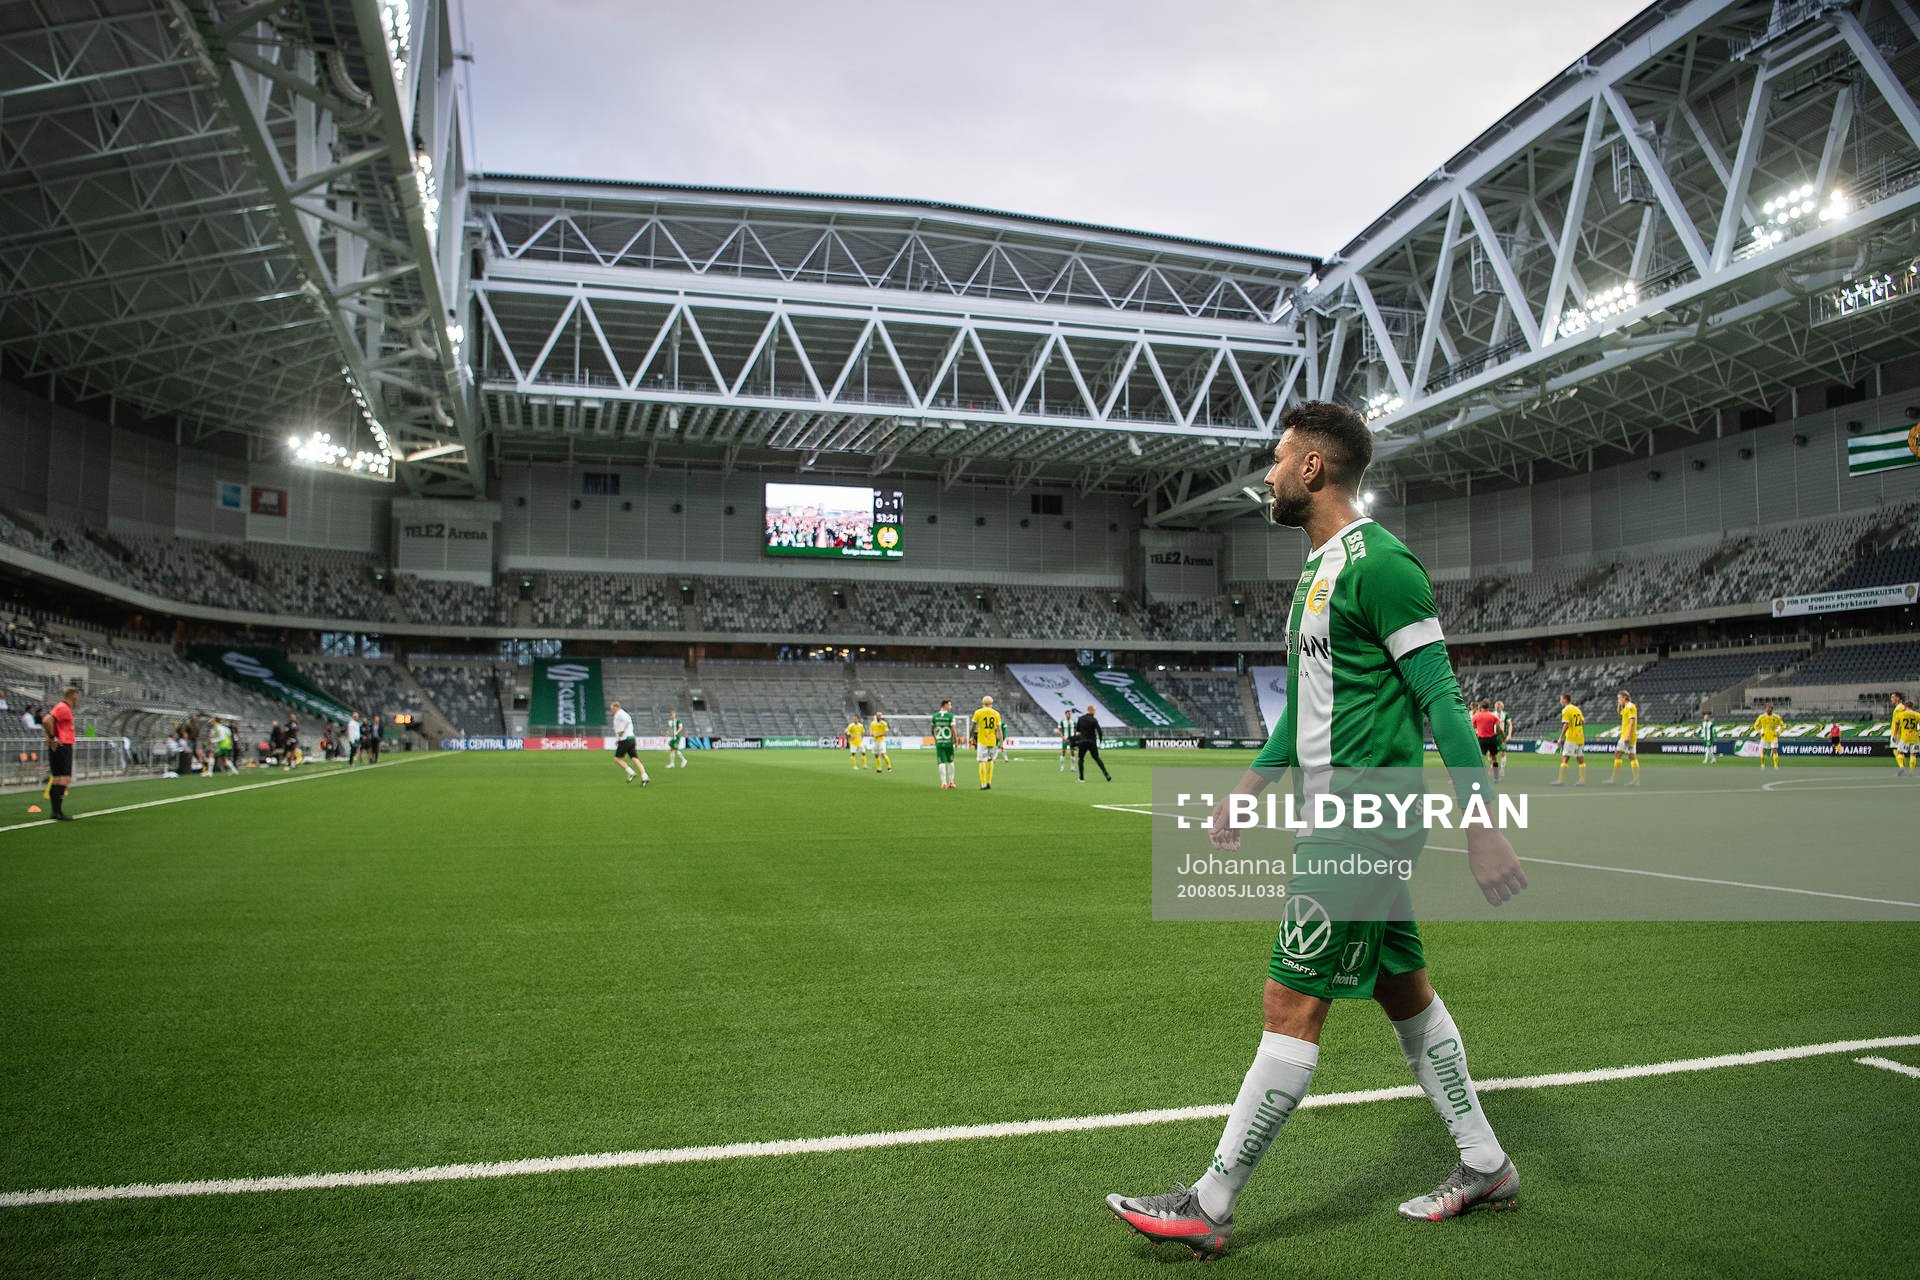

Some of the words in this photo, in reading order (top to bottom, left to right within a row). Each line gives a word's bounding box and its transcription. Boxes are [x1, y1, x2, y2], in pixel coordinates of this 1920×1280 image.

[404, 523, 446, 539] TELE2
[447, 527, 488, 541] Arena
[1150, 551, 1182, 565] TELE2
[983, 716, 996, 730] 18
[1902, 718, 1916, 730] 25
[935, 726, 952, 740] 20
[451, 738, 467, 750] THE
[468, 738, 506, 750] CENTRAL
[506, 738, 524, 750] BAR
[541, 737, 588, 750] Scandic
[1145, 738, 1200, 749] METODGOLV
[1782, 745, 1799, 754] VERY
[1282, 957, 1311, 974] CRAFT
[1426, 1037, 1474, 1117] Clinton
[1236, 1088, 1298, 1168] Clinton
